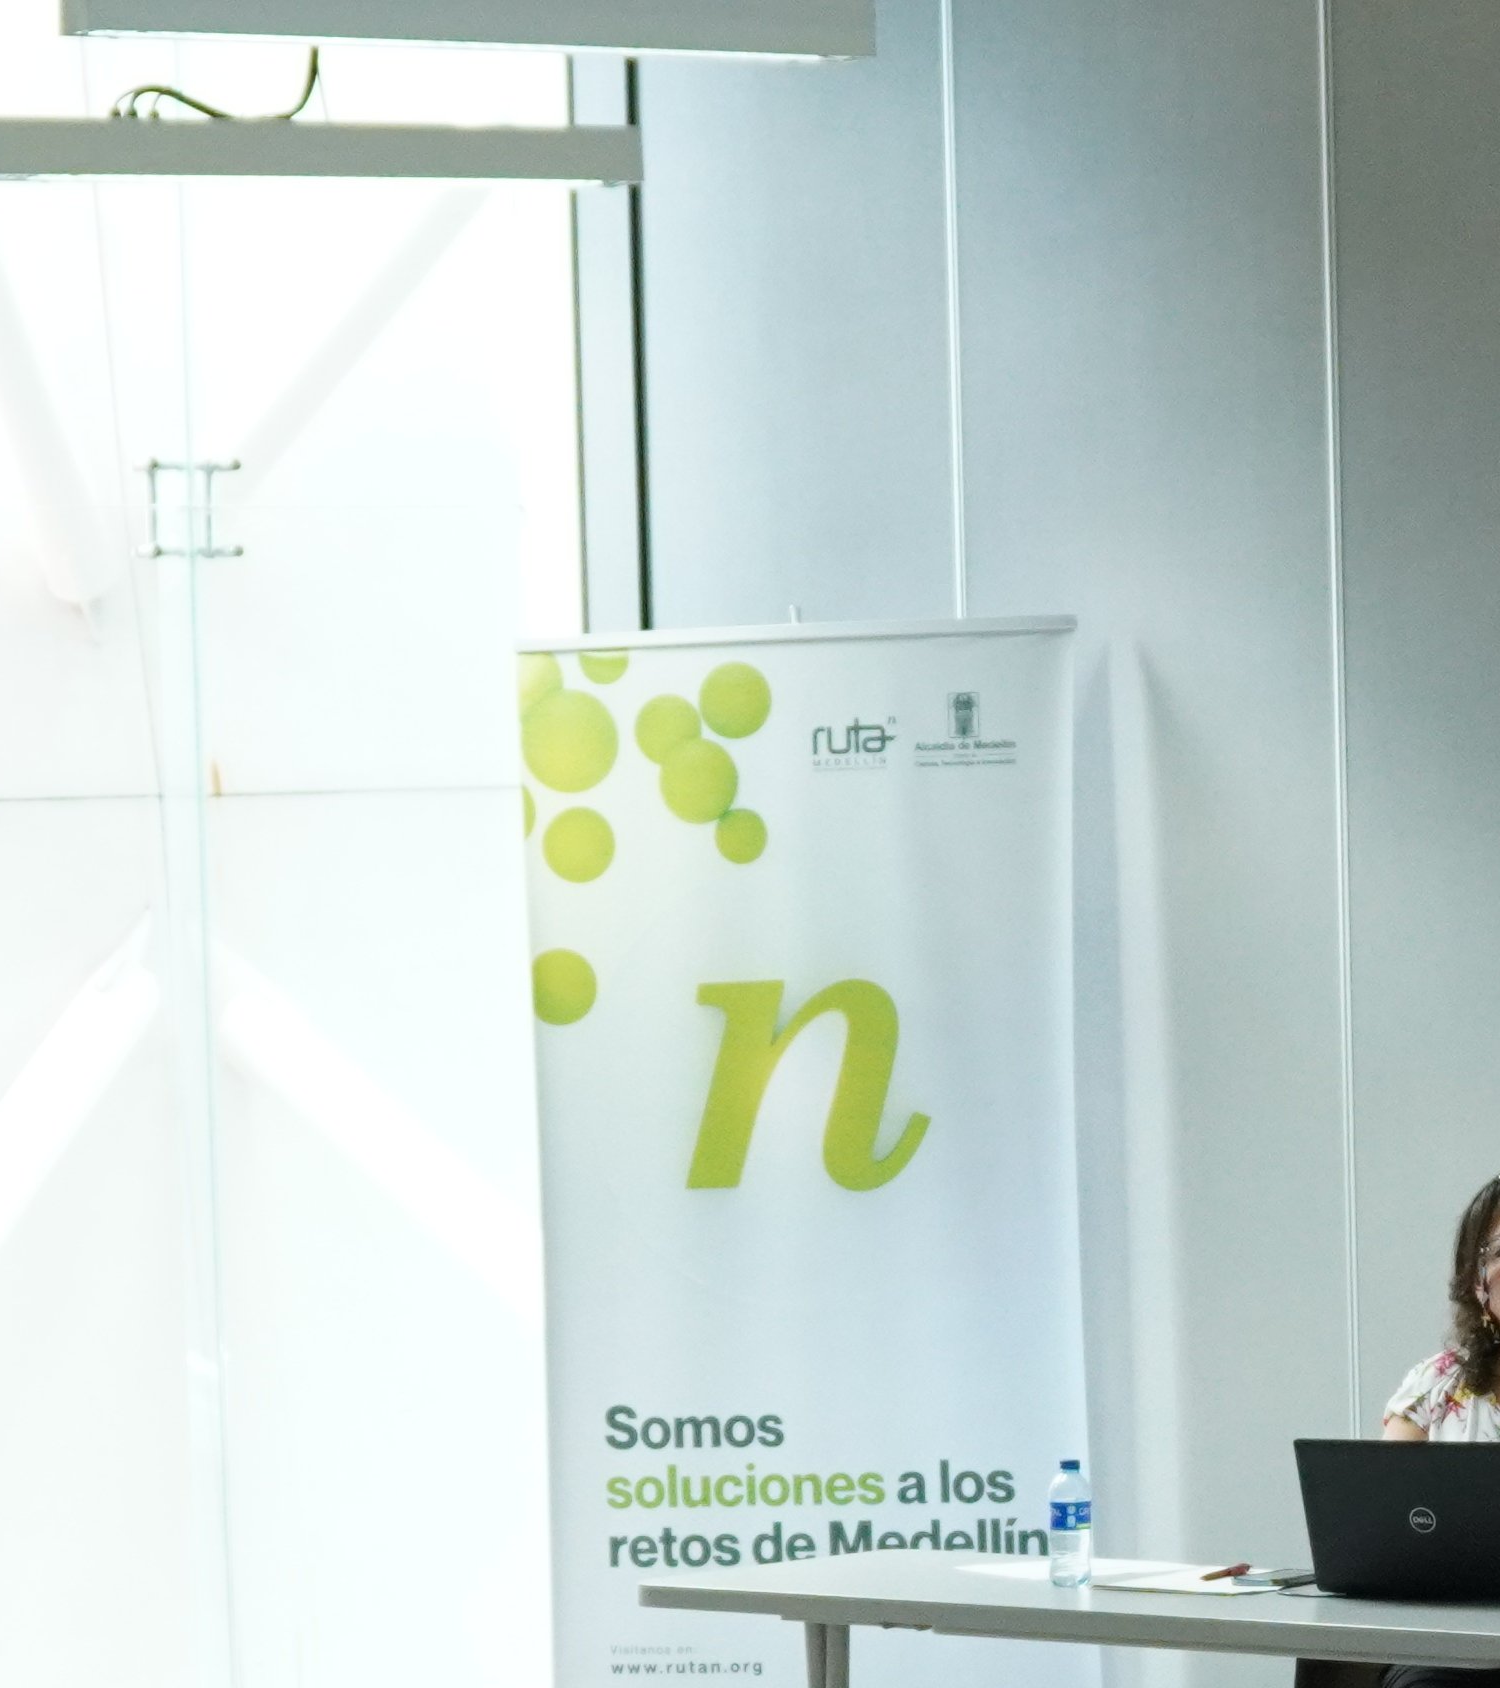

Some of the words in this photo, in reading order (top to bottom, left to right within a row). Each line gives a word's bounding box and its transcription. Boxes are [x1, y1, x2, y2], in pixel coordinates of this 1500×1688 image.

[812, 717, 897, 755] ruta
[686, 978, 931, 1191] n
[605, 1404, 784, 1450] Somos
[605, 1462, 886, 1510] soluciones
[897, 1471, 927, 1504] a
[940, 1459, 1016, 1503] los
[608, 1526, 742, 1568] retos
[752, 1521, 816, 1565] de
[610, 1660, 764, 1677] www.rutan.org
